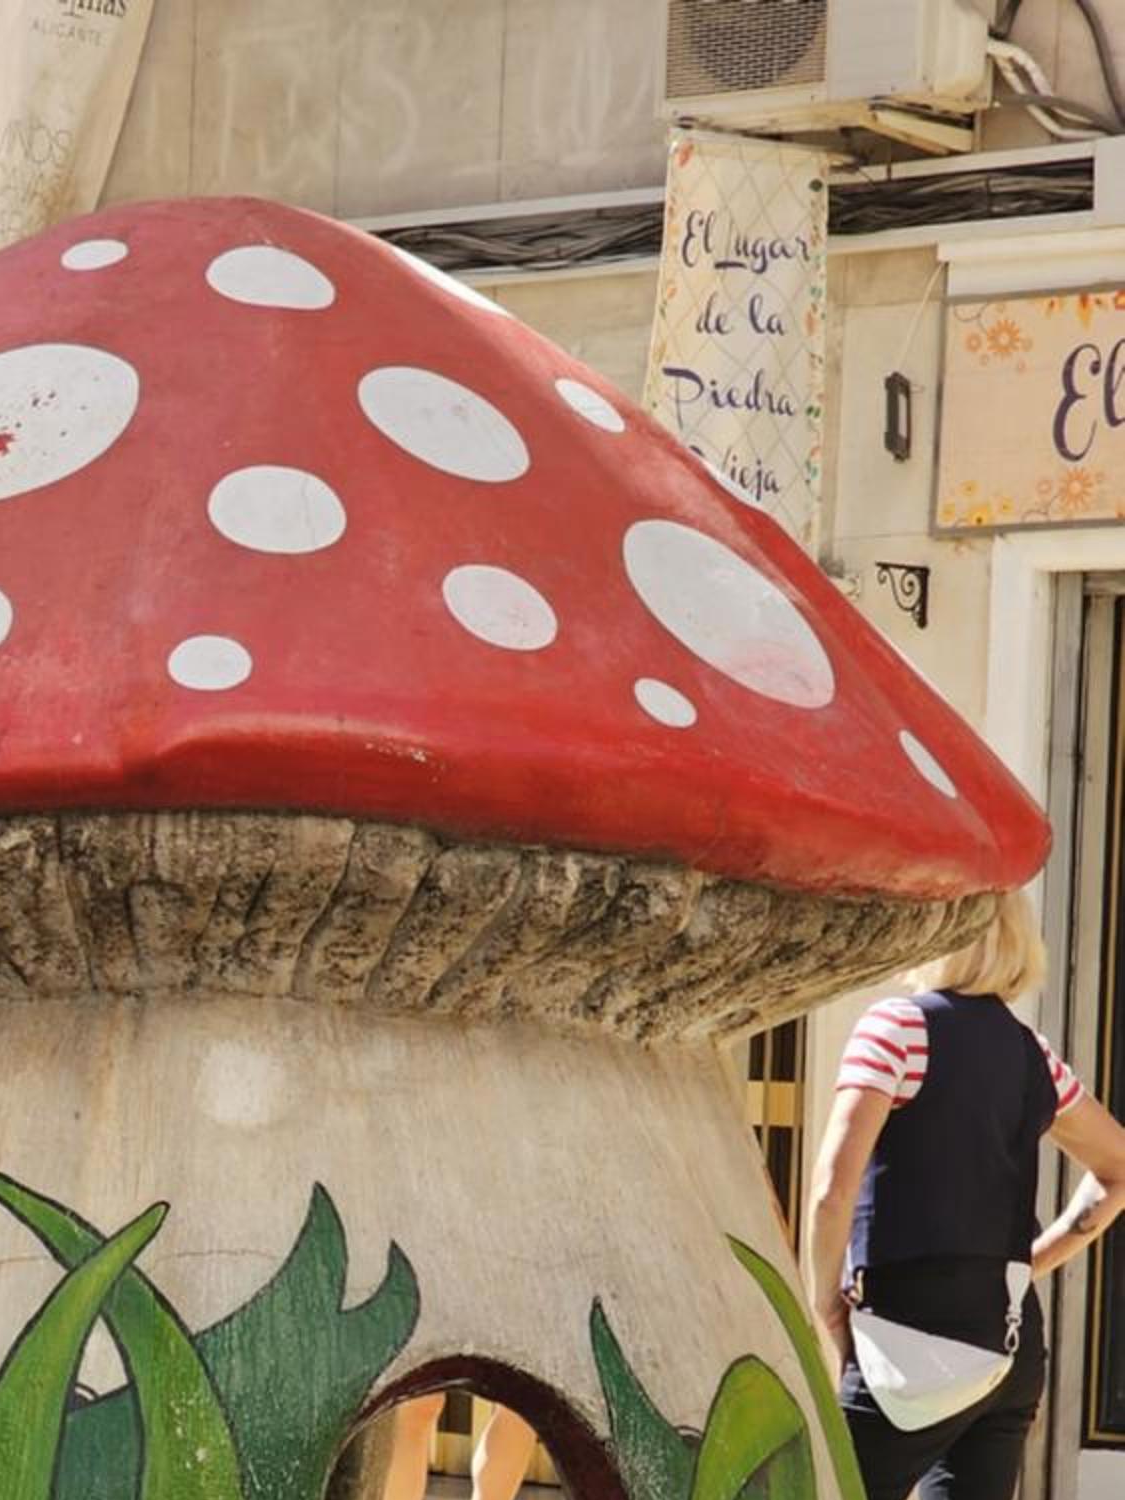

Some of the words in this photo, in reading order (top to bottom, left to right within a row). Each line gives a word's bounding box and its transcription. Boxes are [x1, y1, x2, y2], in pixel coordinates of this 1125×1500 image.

[681, 209, 716, 268] El
[696, 293, 730, 336] de
[749, 293, 787, 337] la
[662, 366, 796, 430] Piedra
[1052, 337, 1125, 462] El
